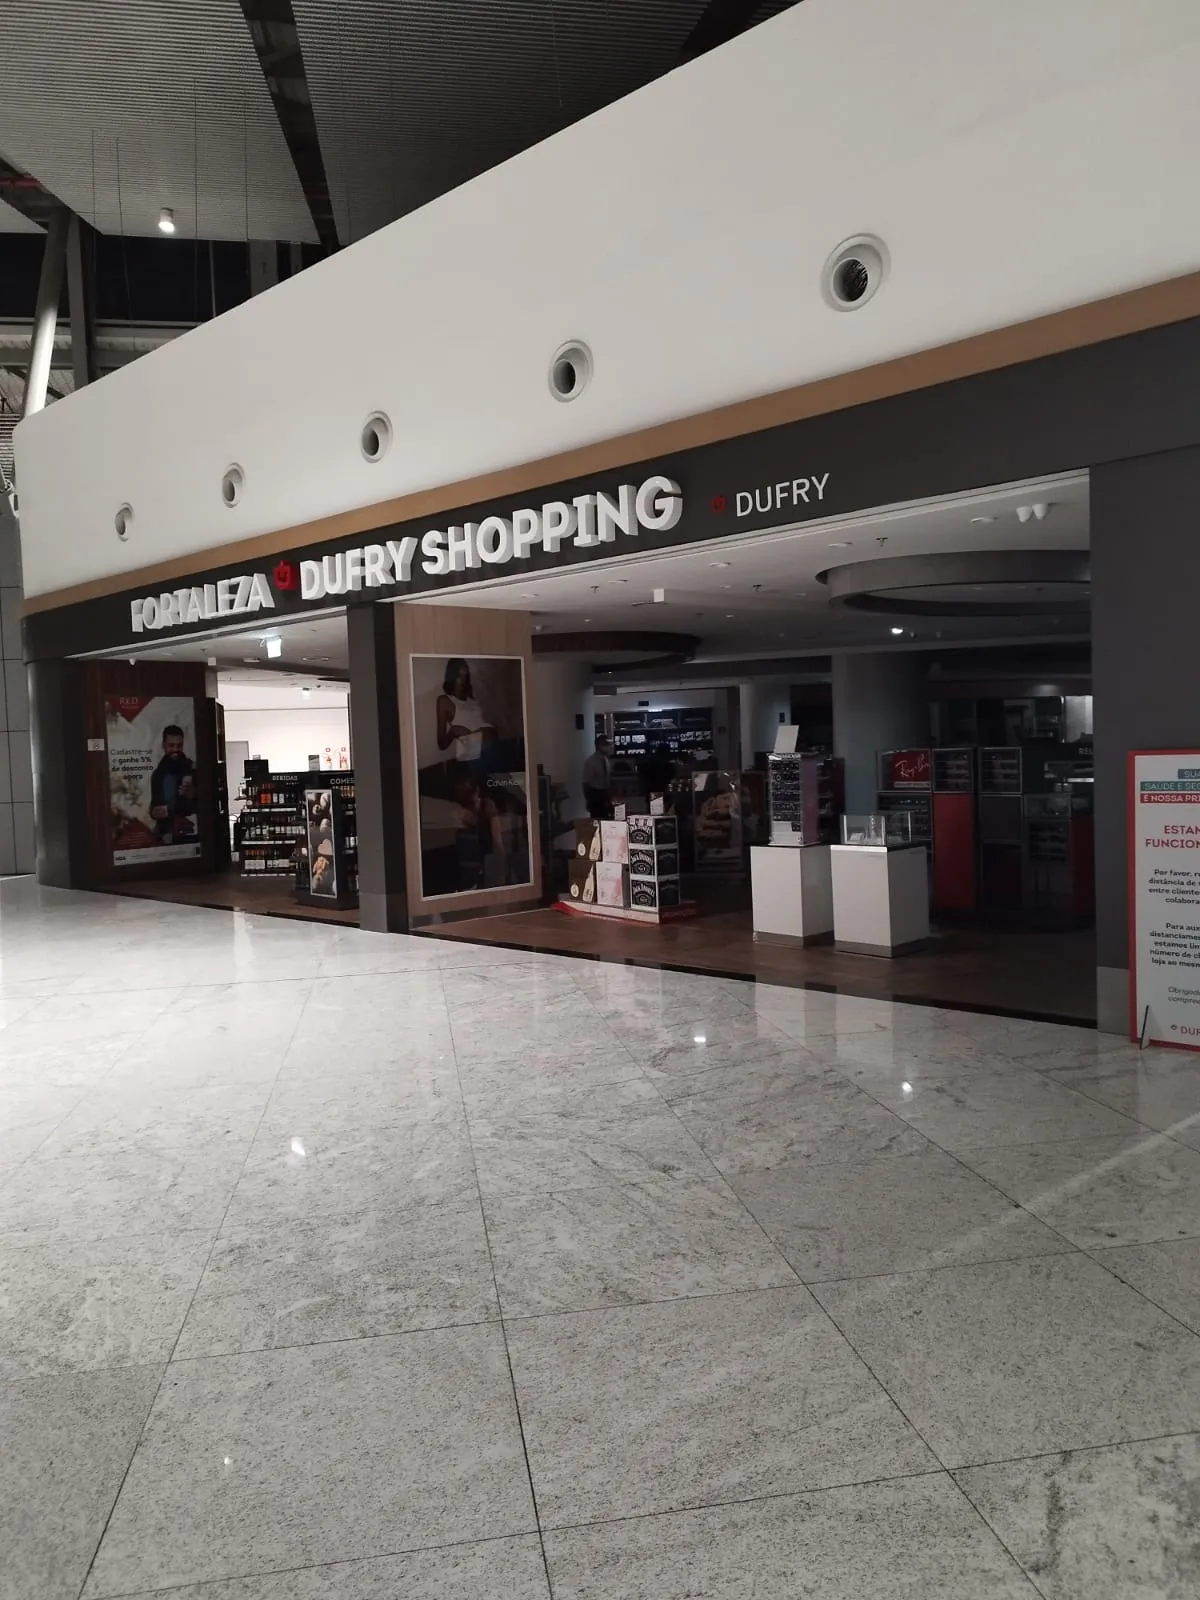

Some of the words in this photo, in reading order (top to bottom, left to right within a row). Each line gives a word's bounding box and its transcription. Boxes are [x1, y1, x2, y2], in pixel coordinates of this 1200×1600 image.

[736, 473, 830, 517] DUFRY
[131, 573, 275, 632] FORTALEZA
[300, 537, 418, 600] DUFRY
[421, 475, 684, 576] SHOPPING
[1151, 794, 1184, 802] NOSSA
[1154, 868, 1168, 876] Por
[1166, 922, 1184, 930] Para
